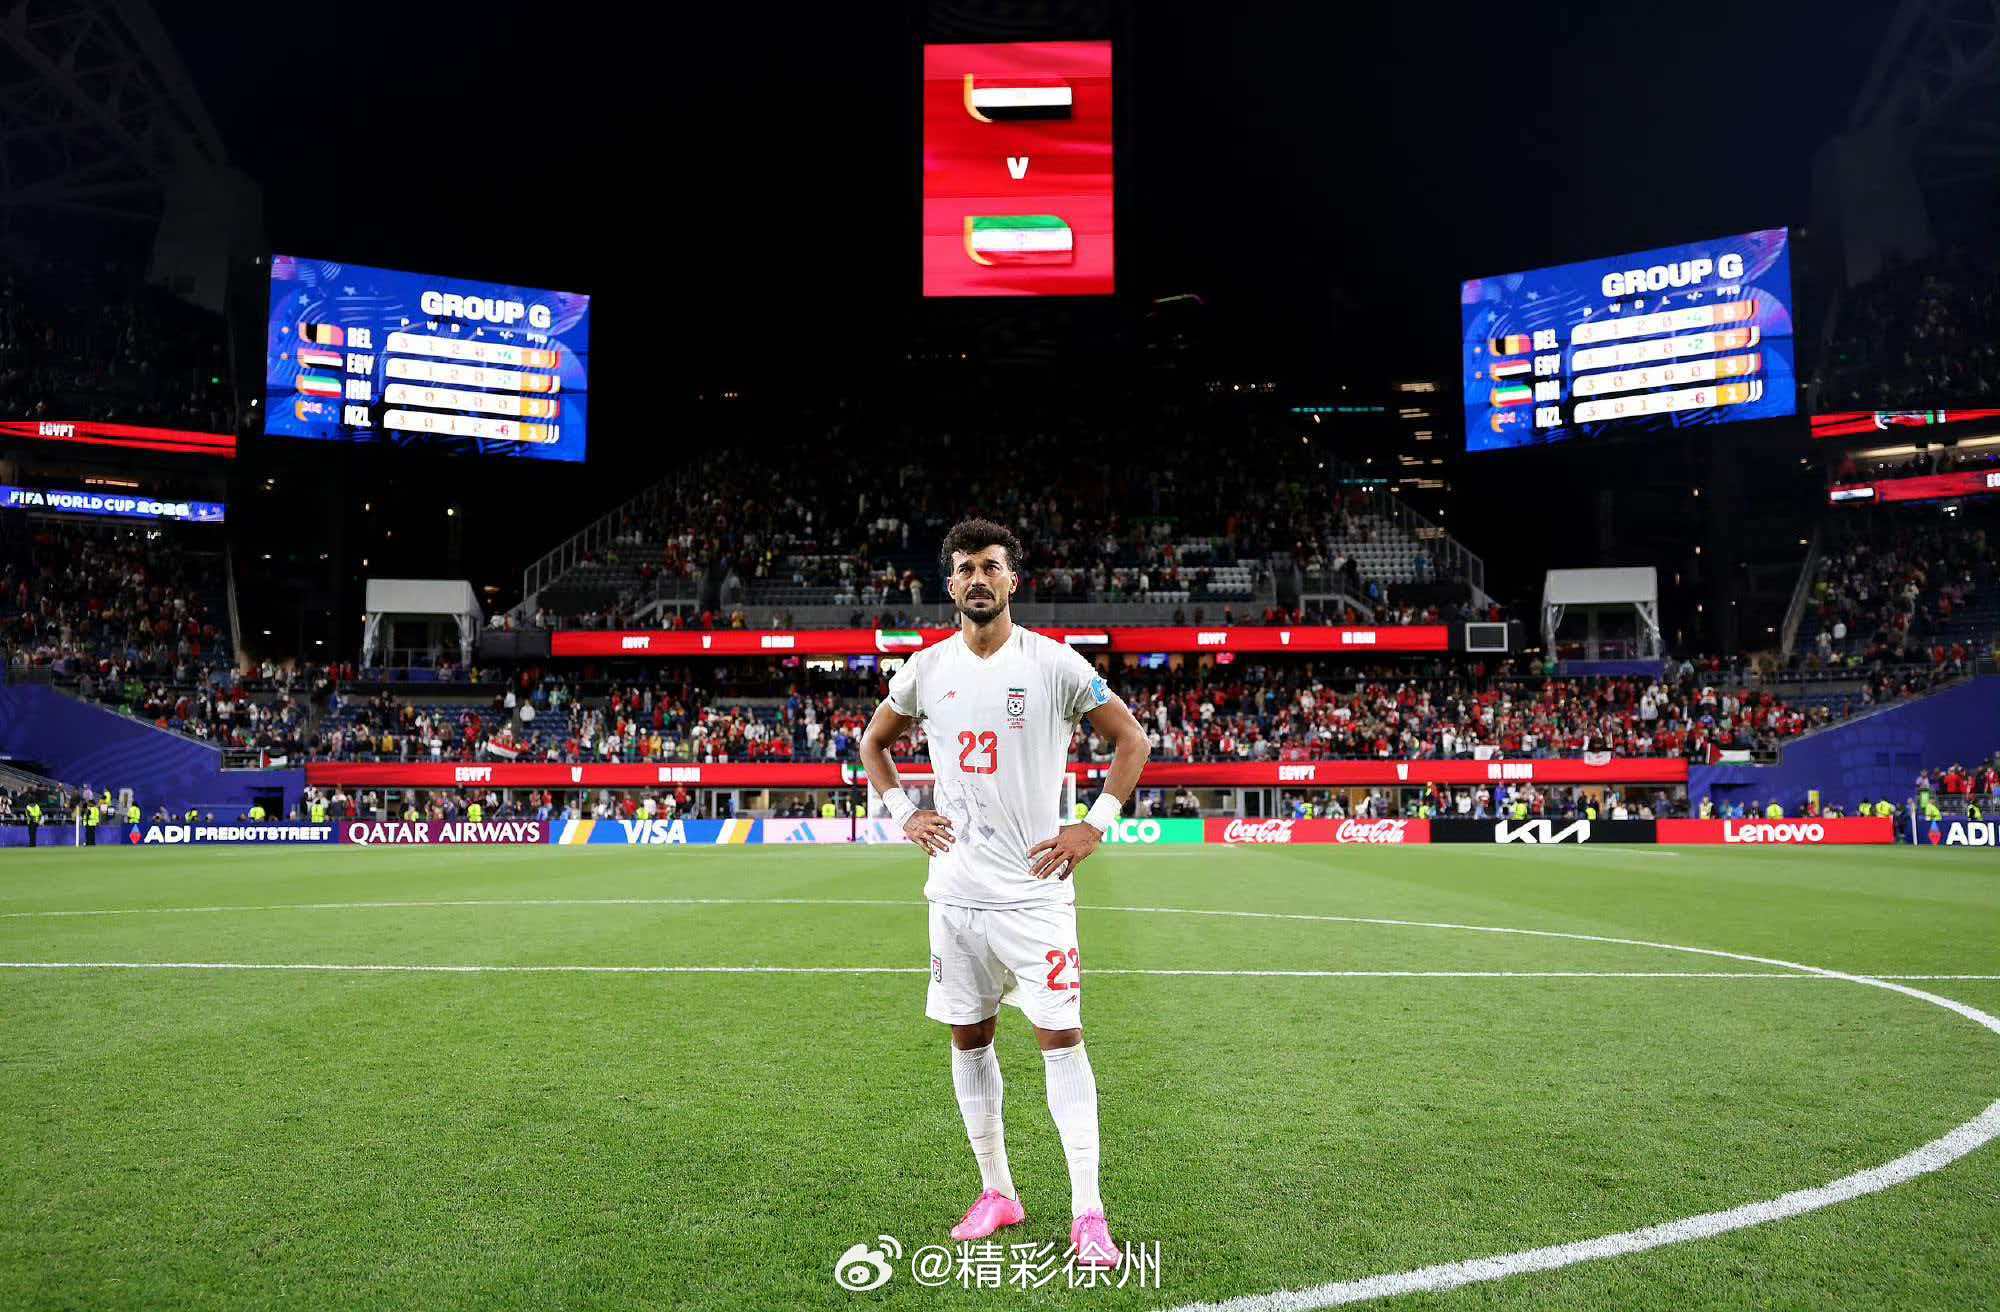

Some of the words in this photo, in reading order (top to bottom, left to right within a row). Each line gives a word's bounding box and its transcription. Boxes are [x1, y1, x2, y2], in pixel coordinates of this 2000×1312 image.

[1602, 258, 1713, 298] GROUP
[1718, 253, 1744, 279] G
[421, 291, 525, 324] GROUP
[529, 304, 551, 329] G
[39, 421, 75, 438] EGYPT
[10, 491, 45, 506] FIFA
[46, 493, 103, 511] WORLD
[106, 498, 136, 514] CUP
[136, 503, 189, 517] 2026
[958, 731, 998, 775] 23
[455, 767, 492, 782] EGYPT
[571, 767, 583, 782] V
[1279, 765, 1315, 781] EGYPT
[1396, 764, 1408, 781] V
[144, 825, 191, 843] ADI
[348, 822, 429, 845] QATAR
[438, 822, 541, 844] AIRWAYS
[618, 819, 688, 844] VISA
[1724, 820, 1825, 843] Lenovo
[1946, 822, 1995, 846] ADI
